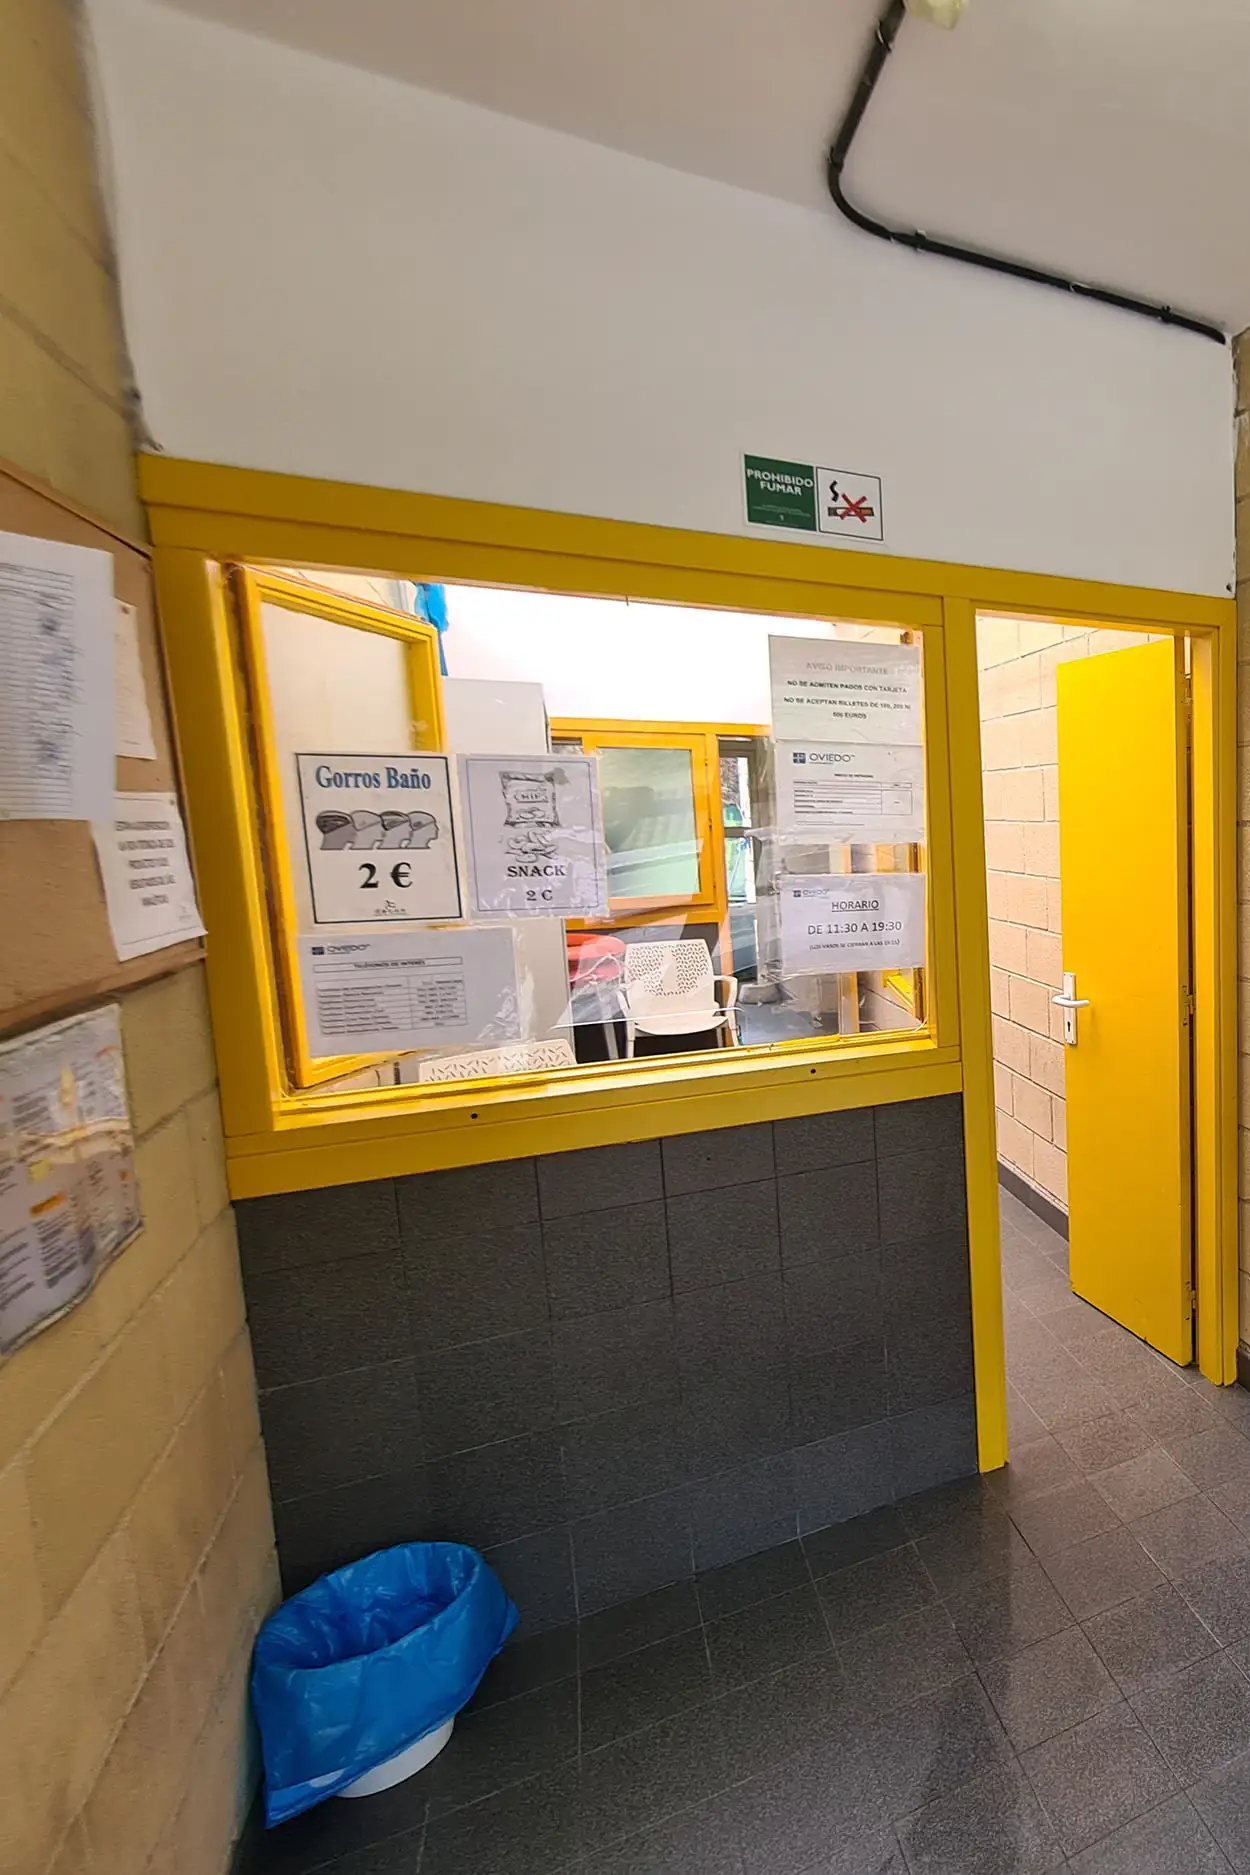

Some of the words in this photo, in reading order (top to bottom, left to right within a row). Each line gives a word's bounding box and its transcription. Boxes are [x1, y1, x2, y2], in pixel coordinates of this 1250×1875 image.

[746, 468, 814, 488] PROHIBIDO
[760, 480, 802, 496] FUMAR
[806, 662, 832, 671] AVISO
[806, 698, 837, 706] ACEPTAN
[838, 700, 868, 708] BILLETES
[809, 753, 851, 763] OVIEDO
[315, 765, 381, 789] Gorros
[384, 766, 432, 789] Baño
[358, 863, 379, 889] 2
[390, 862, 413, 889] €
[507, 865, 567, 878] SNACK
[526, 889, 537, 901] 2
[831, 900, 880, 910] HORARIO
[807, 925, 823, 935] DE
[827, 923, 858, 934] 11:30
[860, 922, 869, 932] A
[871, 921, 902, 932] 19:30
